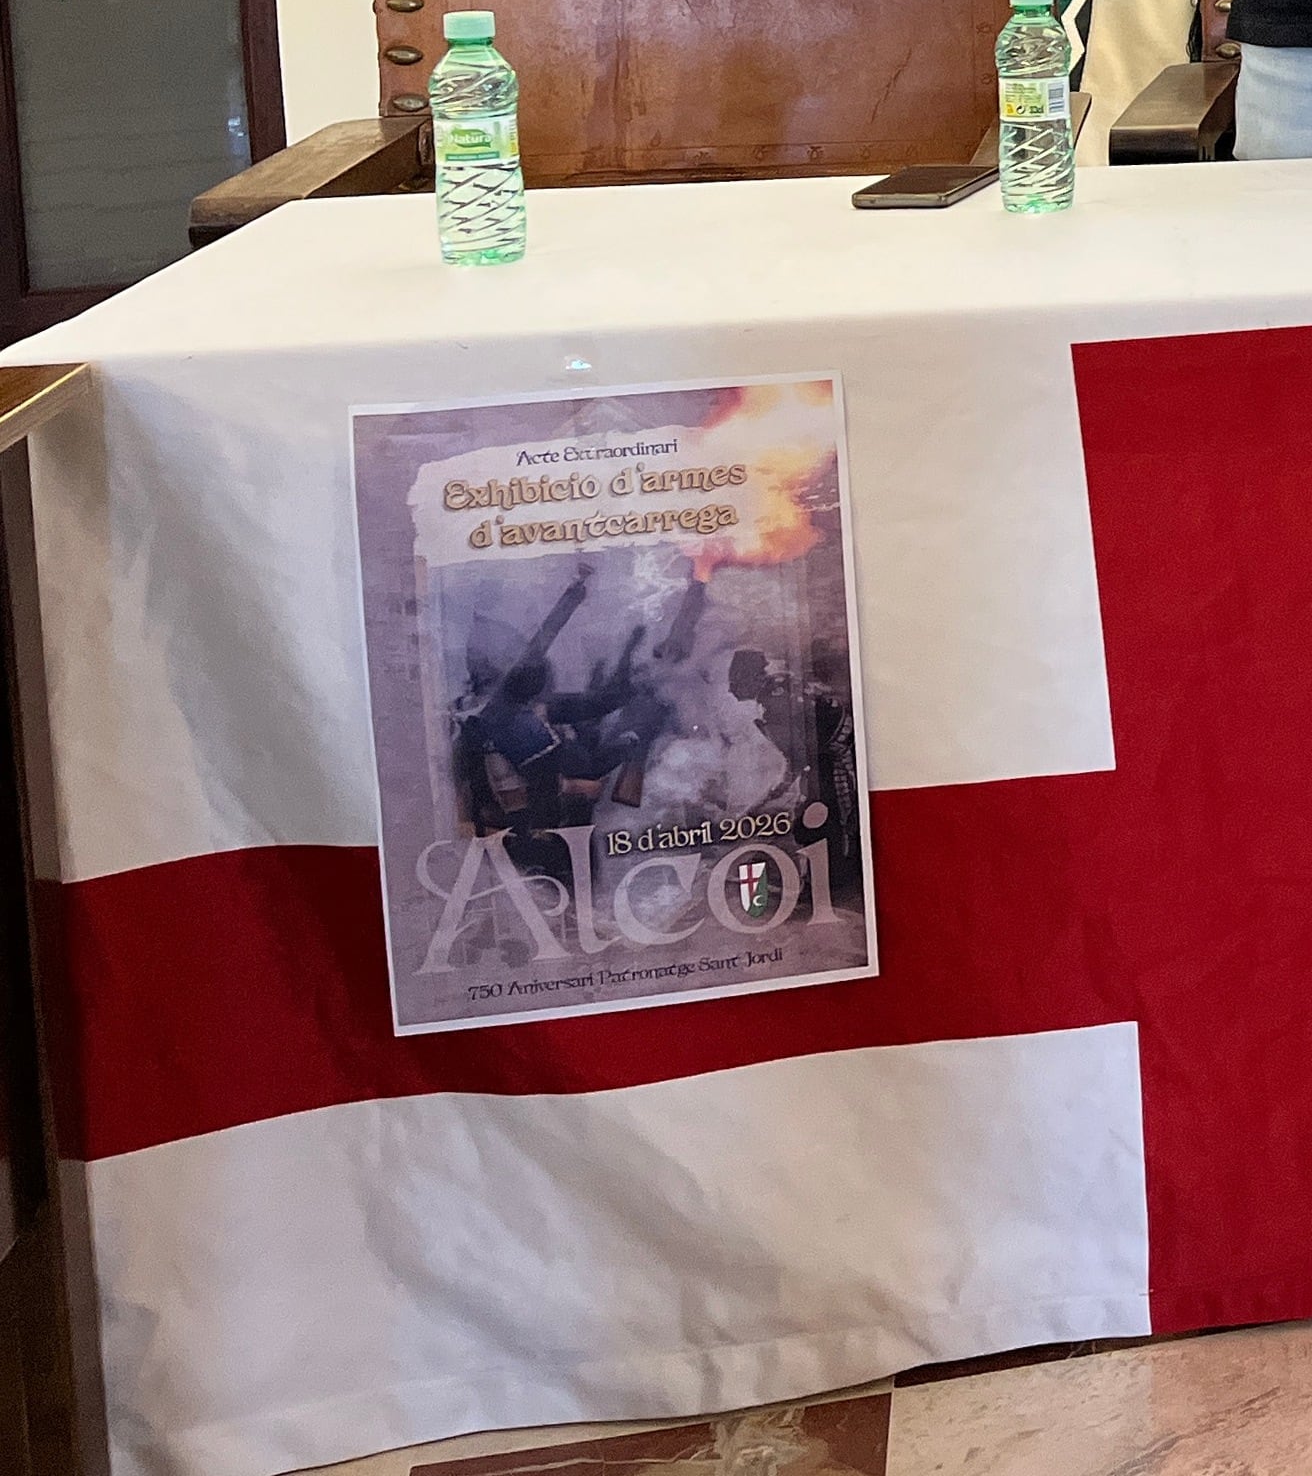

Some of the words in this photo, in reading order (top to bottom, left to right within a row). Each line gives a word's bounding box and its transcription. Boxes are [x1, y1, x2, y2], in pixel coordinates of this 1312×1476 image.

[516, 450, 560, 467] Acte
[563, 438, 679, 462] Extraordinari
[609, 462, 748, 497] d'armes
[468, 502, 740, 550] d'avantcarrega
[607, 831, 632, 857] 18
[637, 821, 713, 853] d'abril
[719, 811, 792, 842] 2026
[412, 800, 846, 976] Alcoi
[468, 982, 504, 1002] 750
[507, 973, 596, 997] Aniversari
[598, 963, 697, 986] Patronatge
[698, 954, 741, 974] Sant
[743, 946, 784, 969] Jordi
